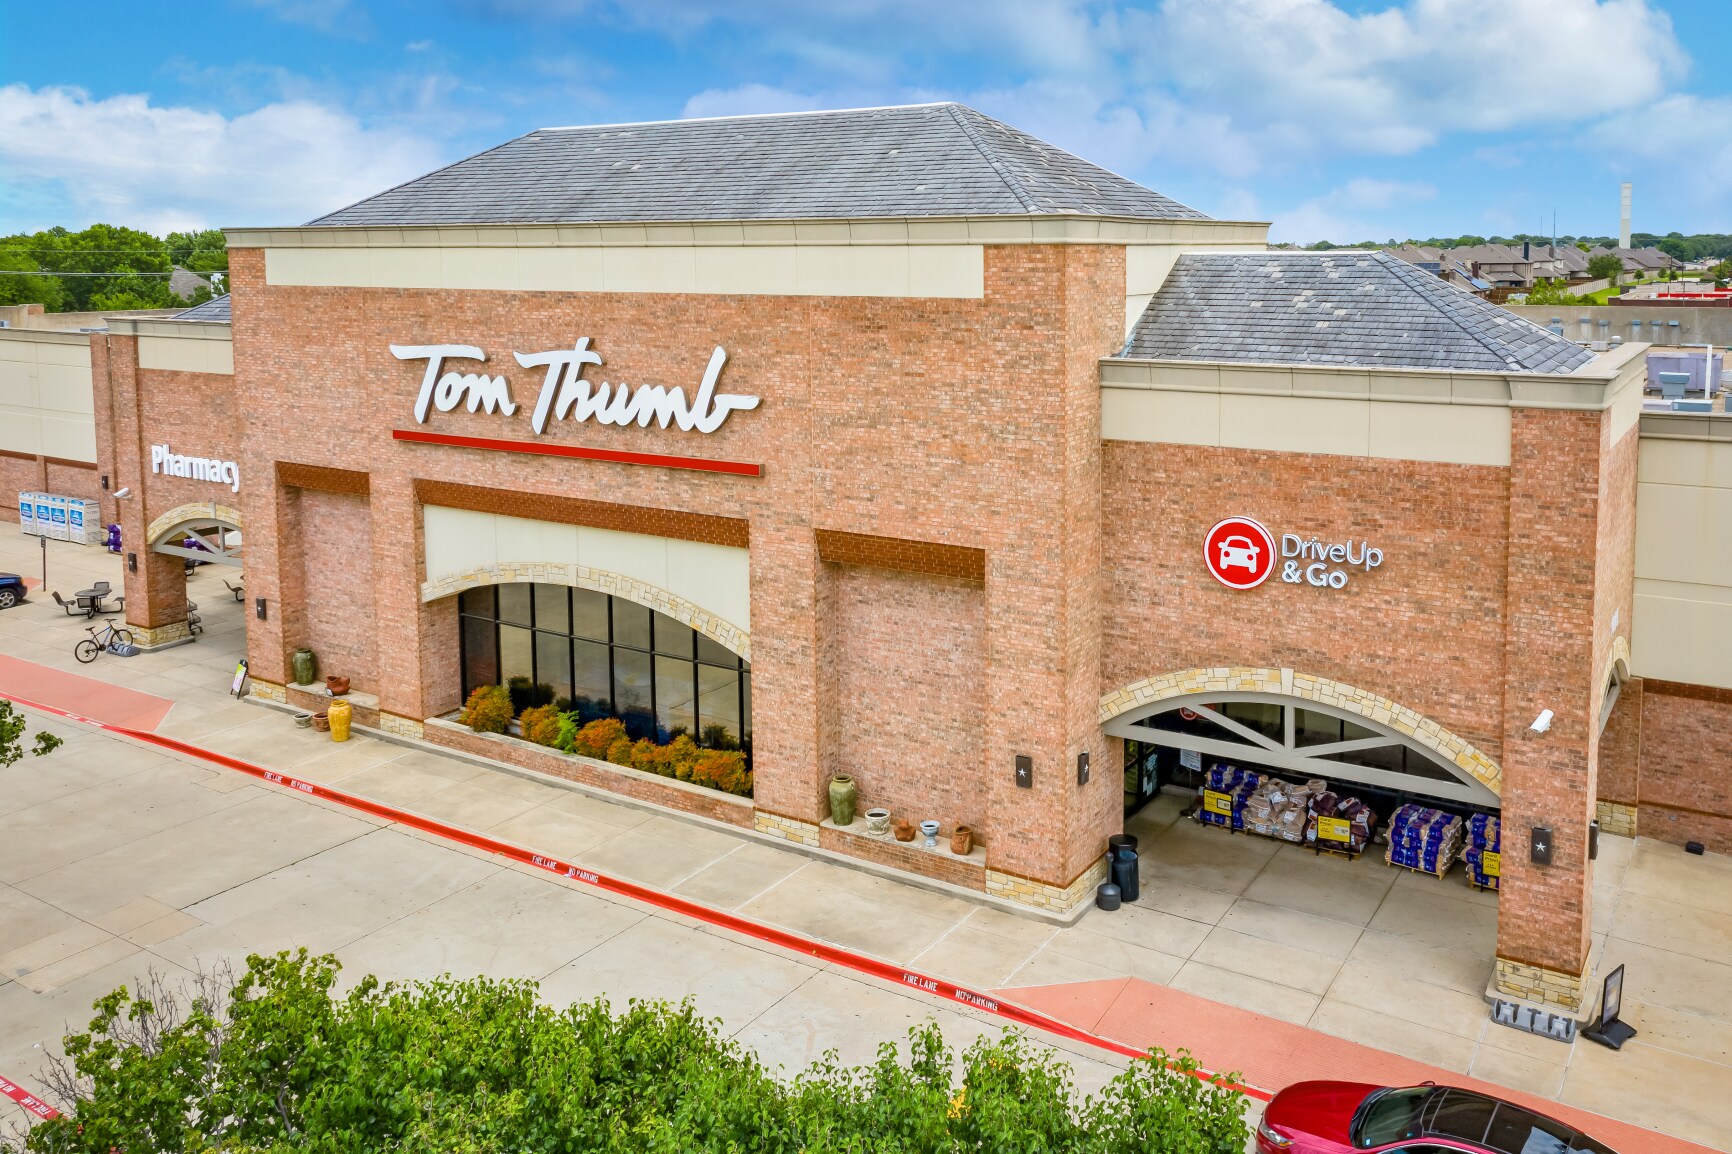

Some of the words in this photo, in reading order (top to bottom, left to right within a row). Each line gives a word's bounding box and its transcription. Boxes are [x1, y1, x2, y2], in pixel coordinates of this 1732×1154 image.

[389, 343, 518, 425] Tom
[512, 336, 761, 435] Thumb
[151, 444, 240, 493] Pharmacy
[1282, 534, 1384, 572] DriveUp
[1282, 559, 1303, 584] &
[1306, 562, 1349, 589] Go
[532, 855, 544, 867] FIRE
[543, 858, 557, 870] LANE
[568, 866, 576, 876] NO
[576, 868, 599, 883] PARKING
[903, 973, 919, 986] FIRE
[918, 978, 938, 992] LANE
[955, 989, 966, 1000] NO
[965, 991, 998, 1011] PARKING
